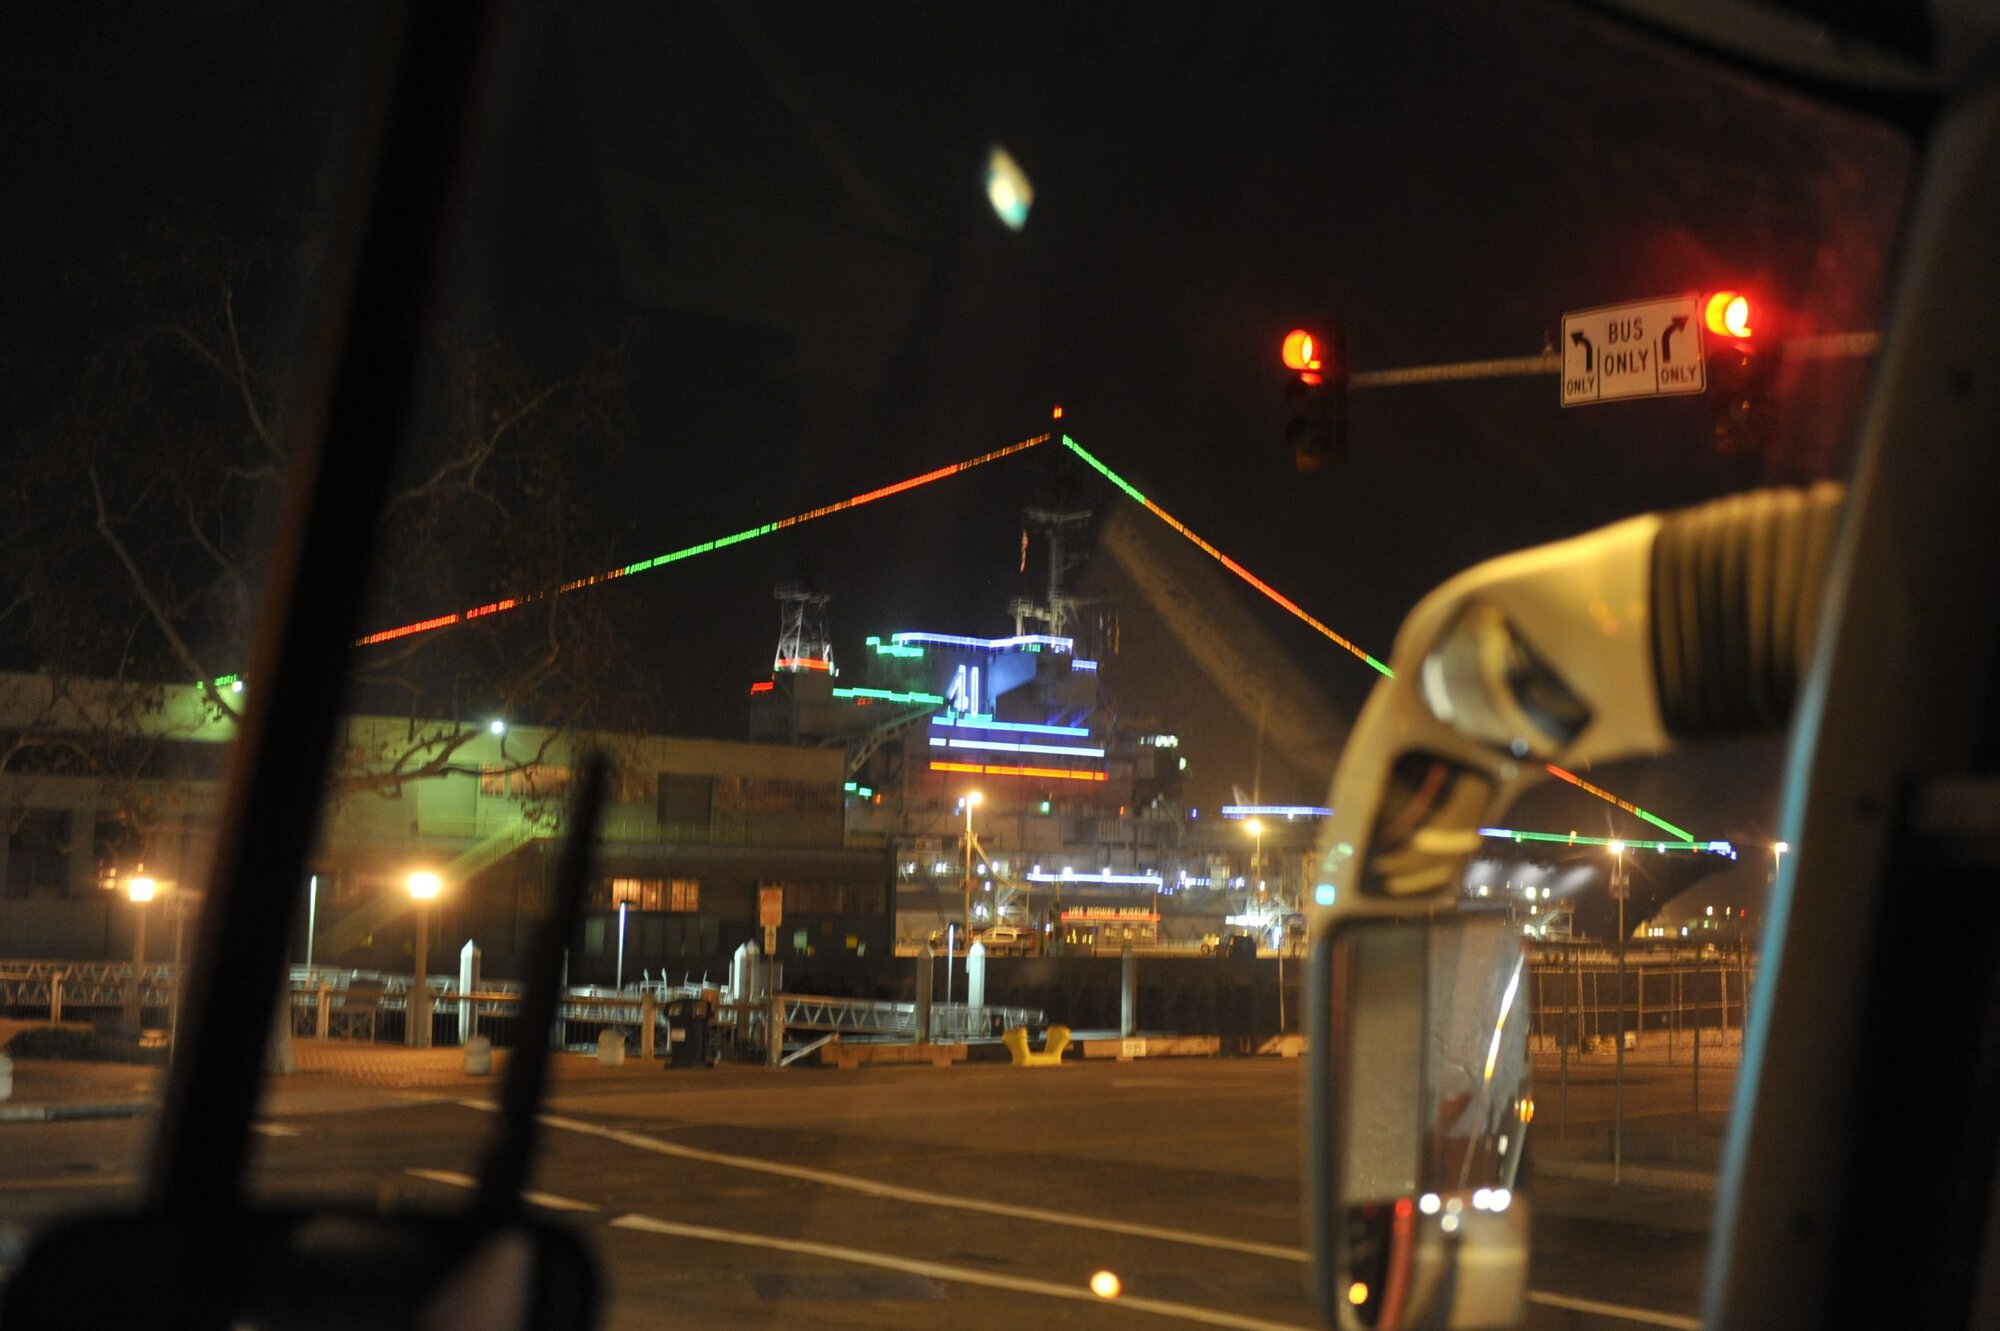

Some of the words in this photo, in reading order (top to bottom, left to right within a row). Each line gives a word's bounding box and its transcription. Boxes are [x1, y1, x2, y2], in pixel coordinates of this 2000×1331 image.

[1608, 317, 1643, 344] BUS
[1604, 349, 1649, 376] ONLY
[1566, 376, 1595, 396] ONLY
[1661, 365, 1697, 385] ONLY
